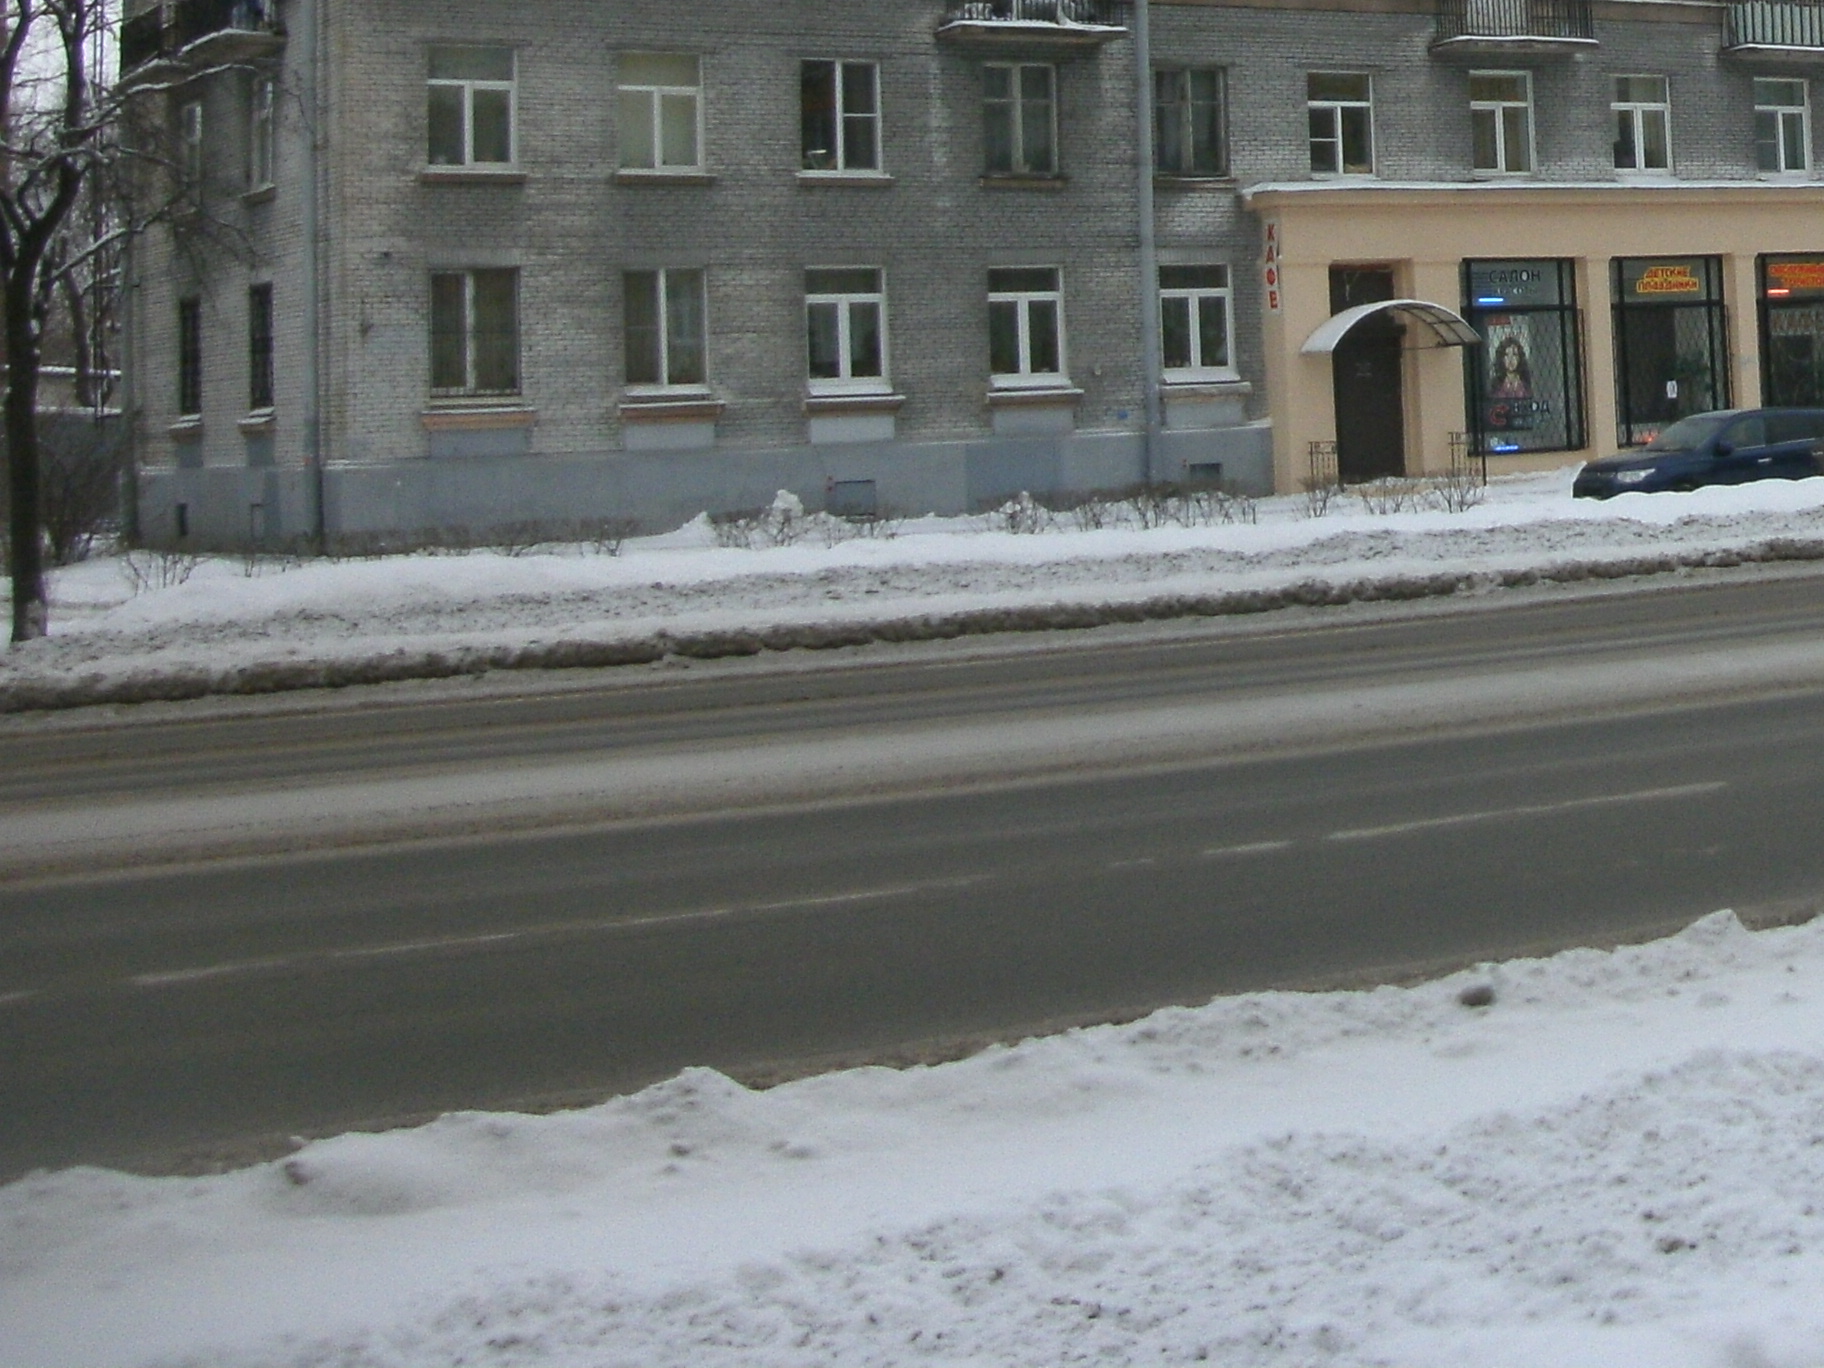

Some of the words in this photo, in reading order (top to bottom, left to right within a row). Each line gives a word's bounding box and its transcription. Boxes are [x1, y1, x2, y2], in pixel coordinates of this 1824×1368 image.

[1266, 222, 1278, 309] КАФЕ
[1644, 266, 1690, 279] ДЕТСКИЕ
[1489, 269, 1541, 283] САЛОН
